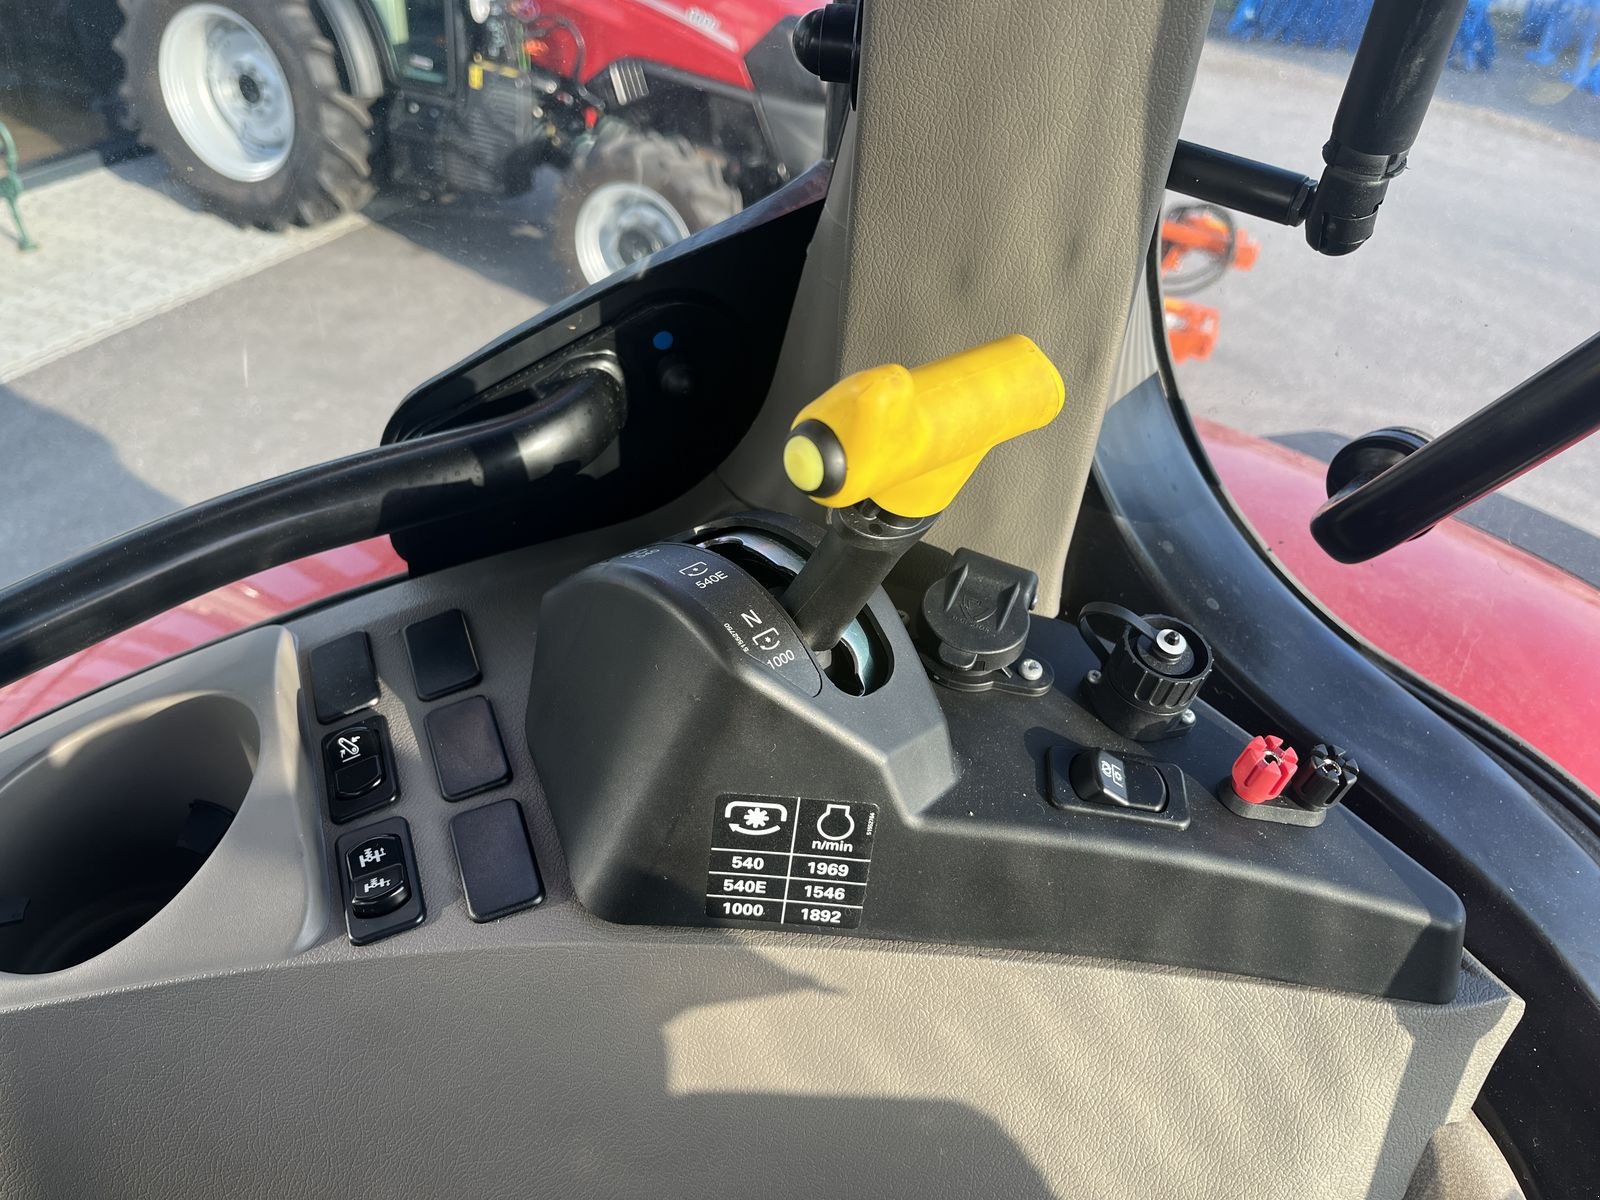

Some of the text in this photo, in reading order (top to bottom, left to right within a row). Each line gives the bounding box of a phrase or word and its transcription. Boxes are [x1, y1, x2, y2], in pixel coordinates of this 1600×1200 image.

[695, 570, 728, 589] 540E
[741, 609, 763, 628] N
[766, 650, 795, 670] 1000
[811, 840, 853, 853] n/min
[731, 856, 765, 871] 540
[807, 861, 850, 877] 1969
[723, 879, 767, 894] 540E
[804, 885, 846, 901] 1546
[722, 902, 764, 917] 1000
[800, 908, 842, 924] 1892
